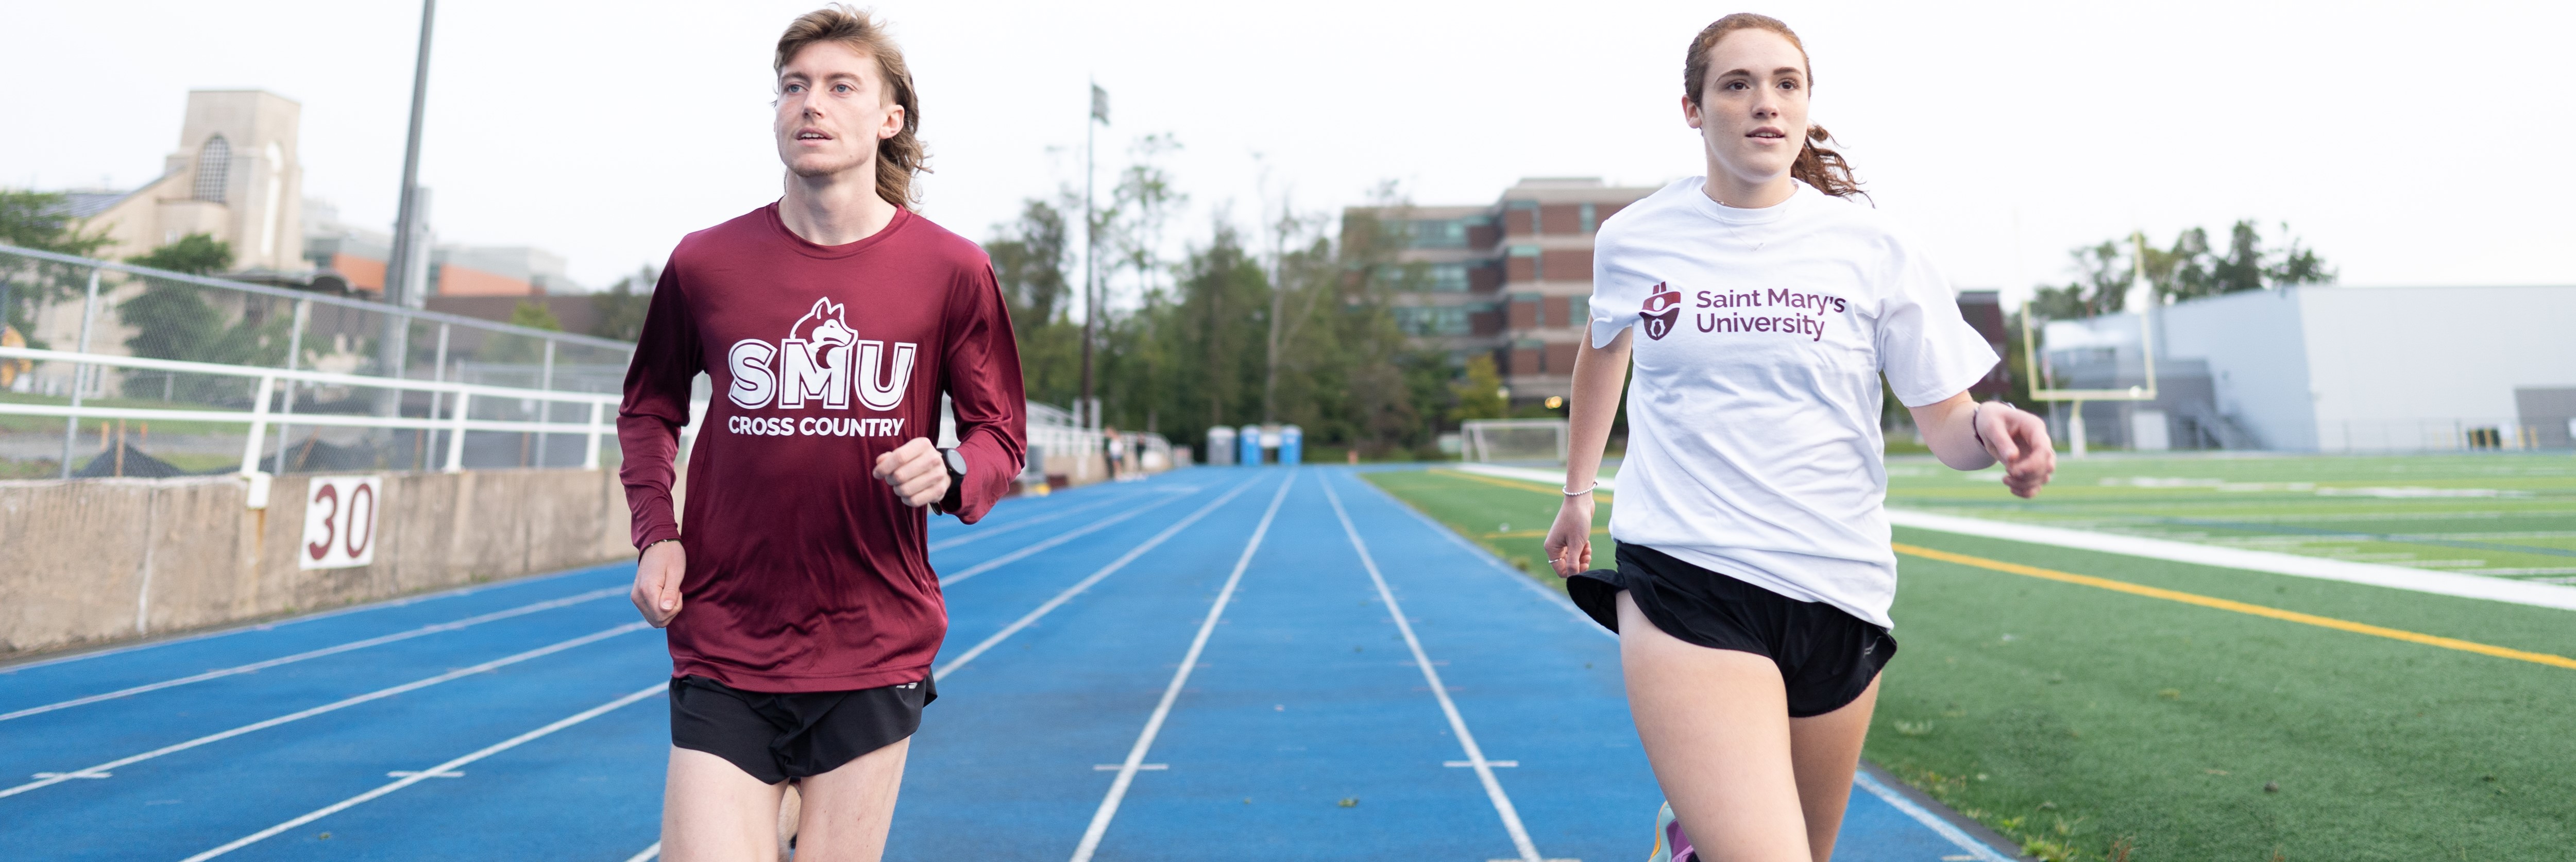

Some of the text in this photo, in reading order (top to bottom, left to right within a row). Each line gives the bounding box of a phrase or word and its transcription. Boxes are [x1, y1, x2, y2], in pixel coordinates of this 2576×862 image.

[1696, 289, 1846, 316] Saint Mary's
[1697, 312, 1825, 342] University
[728, 339, 917, 411] SMU
[728, 416, 905, 437] CROSS COUNTRY
[309, 483, 372, 560] 30
